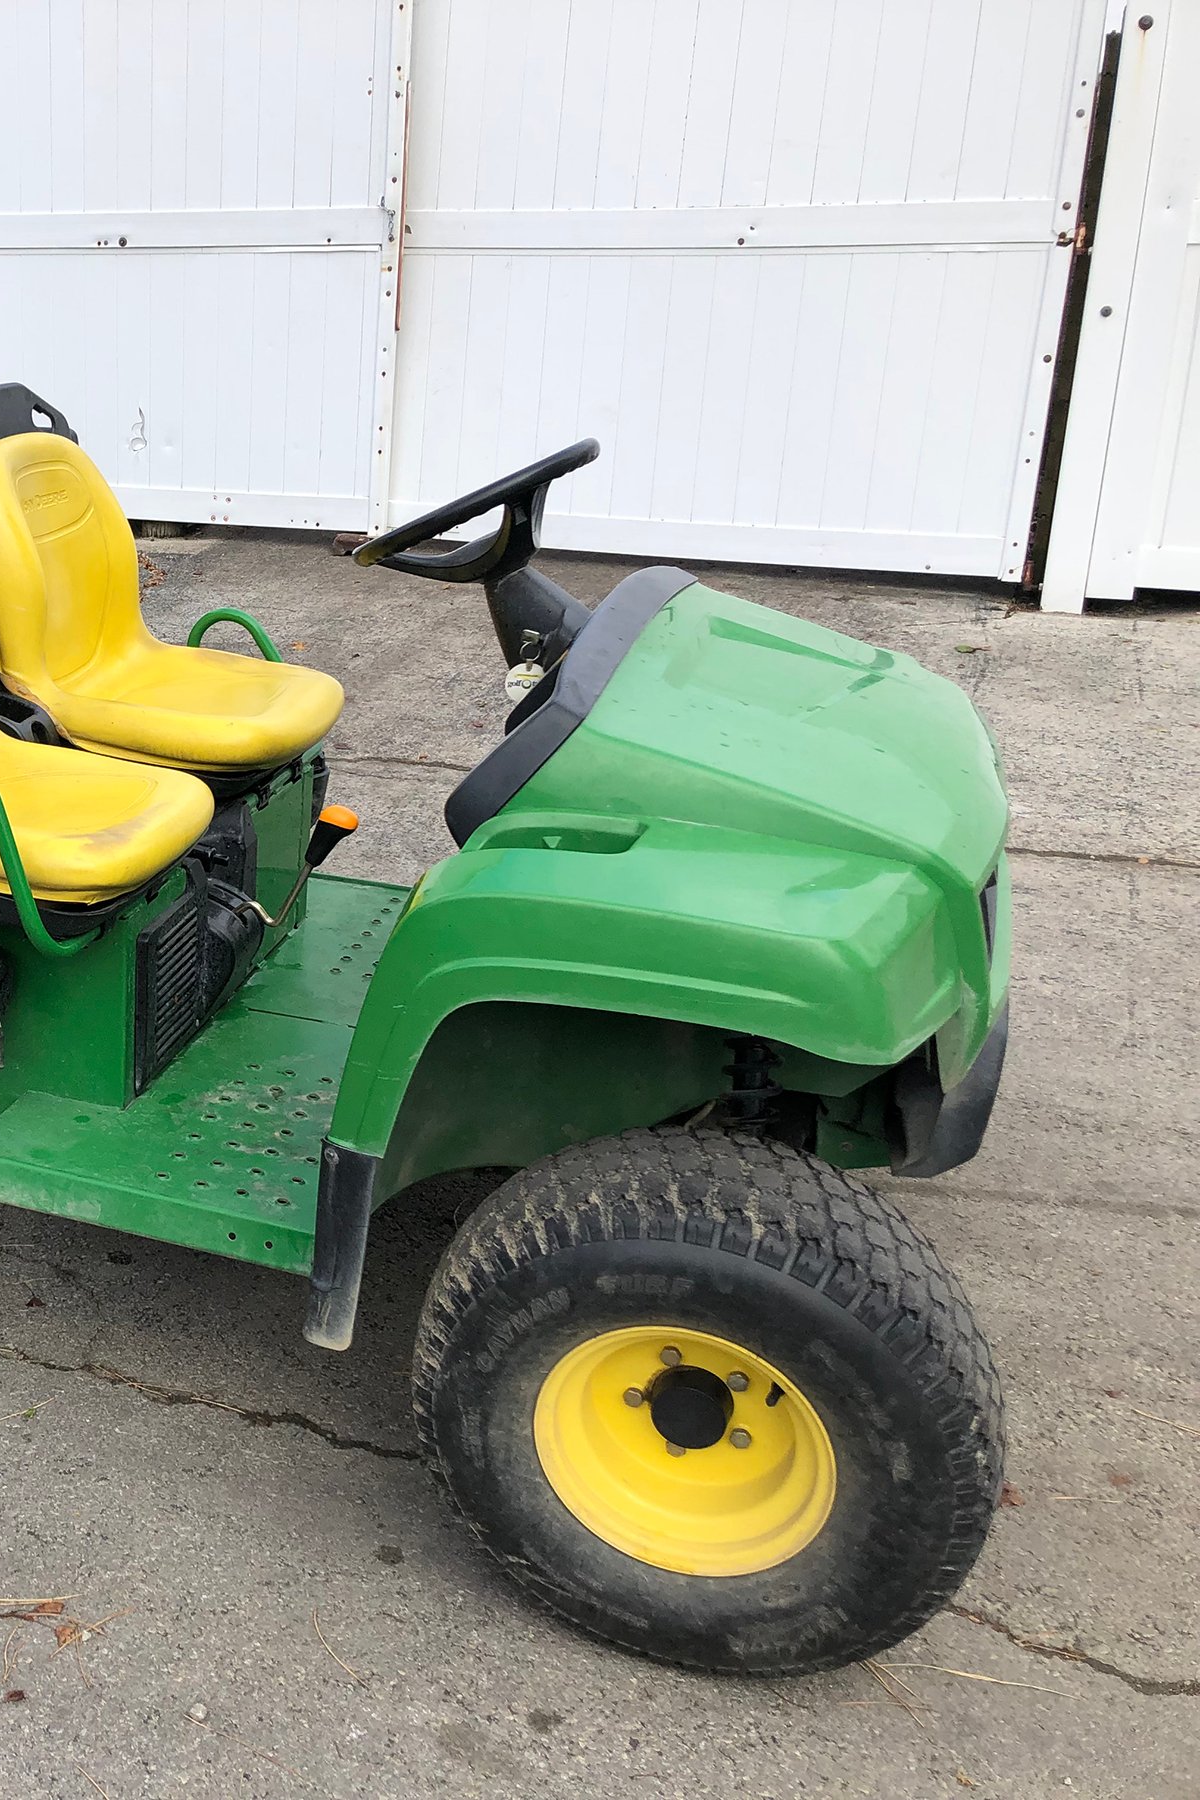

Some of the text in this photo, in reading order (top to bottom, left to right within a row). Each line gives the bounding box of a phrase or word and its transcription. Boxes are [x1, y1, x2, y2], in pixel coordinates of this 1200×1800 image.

[507, 679, 522, 688] golf
[476, 1274, 694, 1373] CAYMAN TURF
